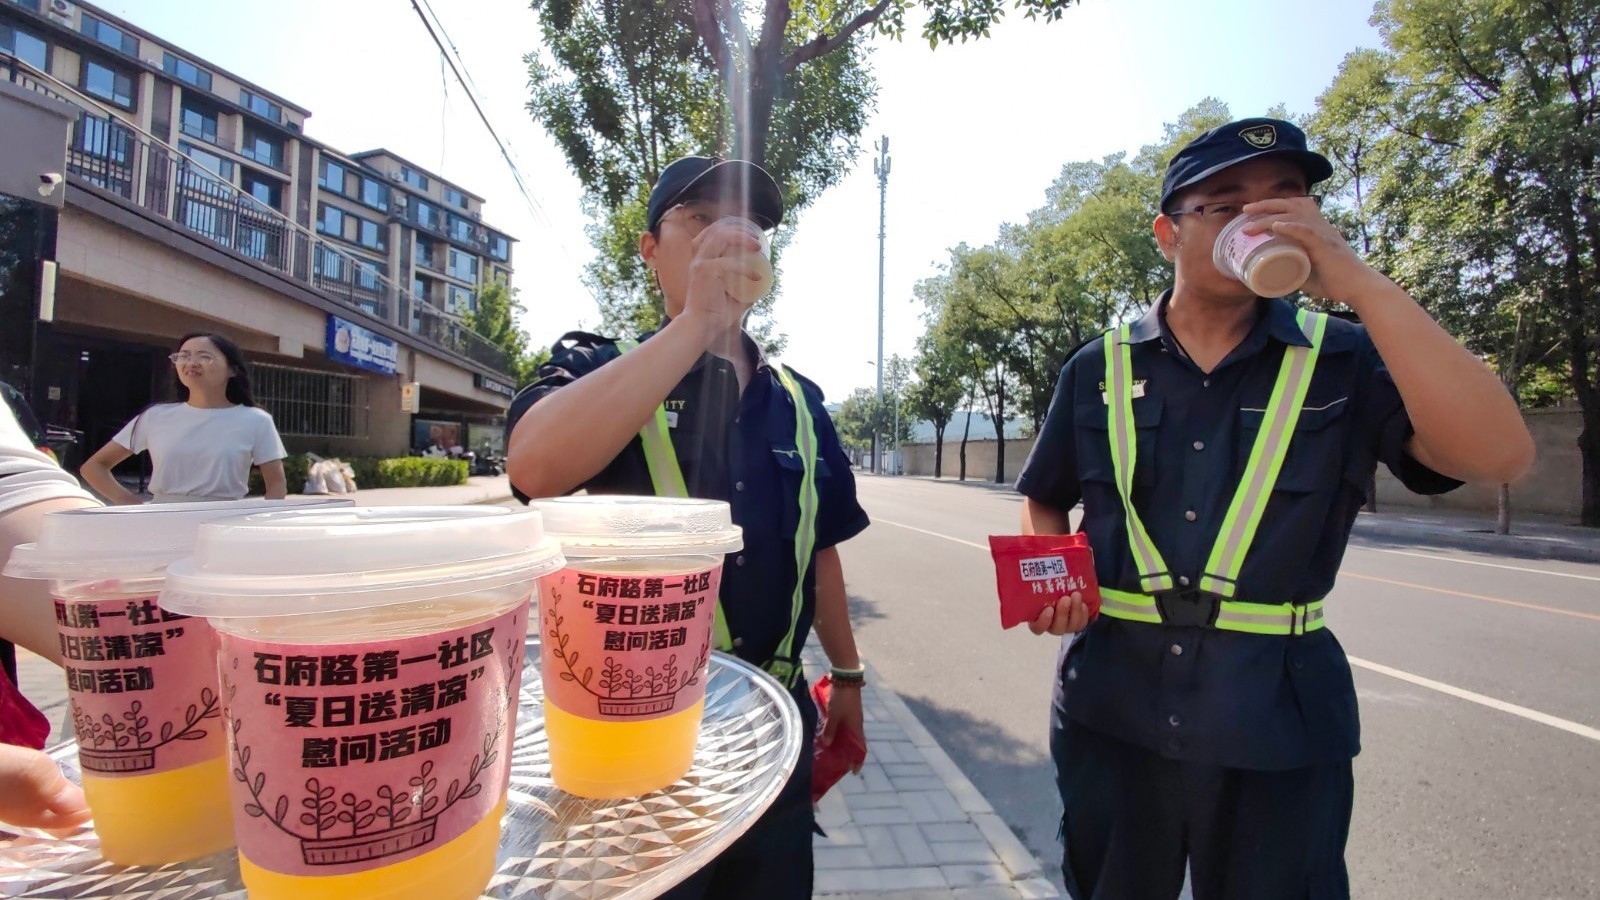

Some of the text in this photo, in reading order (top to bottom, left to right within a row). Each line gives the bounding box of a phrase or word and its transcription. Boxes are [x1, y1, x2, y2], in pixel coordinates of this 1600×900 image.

[1021, 560, 1066, 577] 石府路第一社区
[577, 571, 711, 599] 石府路第一社区
[583, 597, 705, 625] “夏日送清凉”
[603, 626, 687, 651] 慰问活动
[254, 627, 495, 686] 石府路第一社区
[264, 665, 485, 728] “夏日送清凉”
[302, 717, 452, 768] 慰问活动
